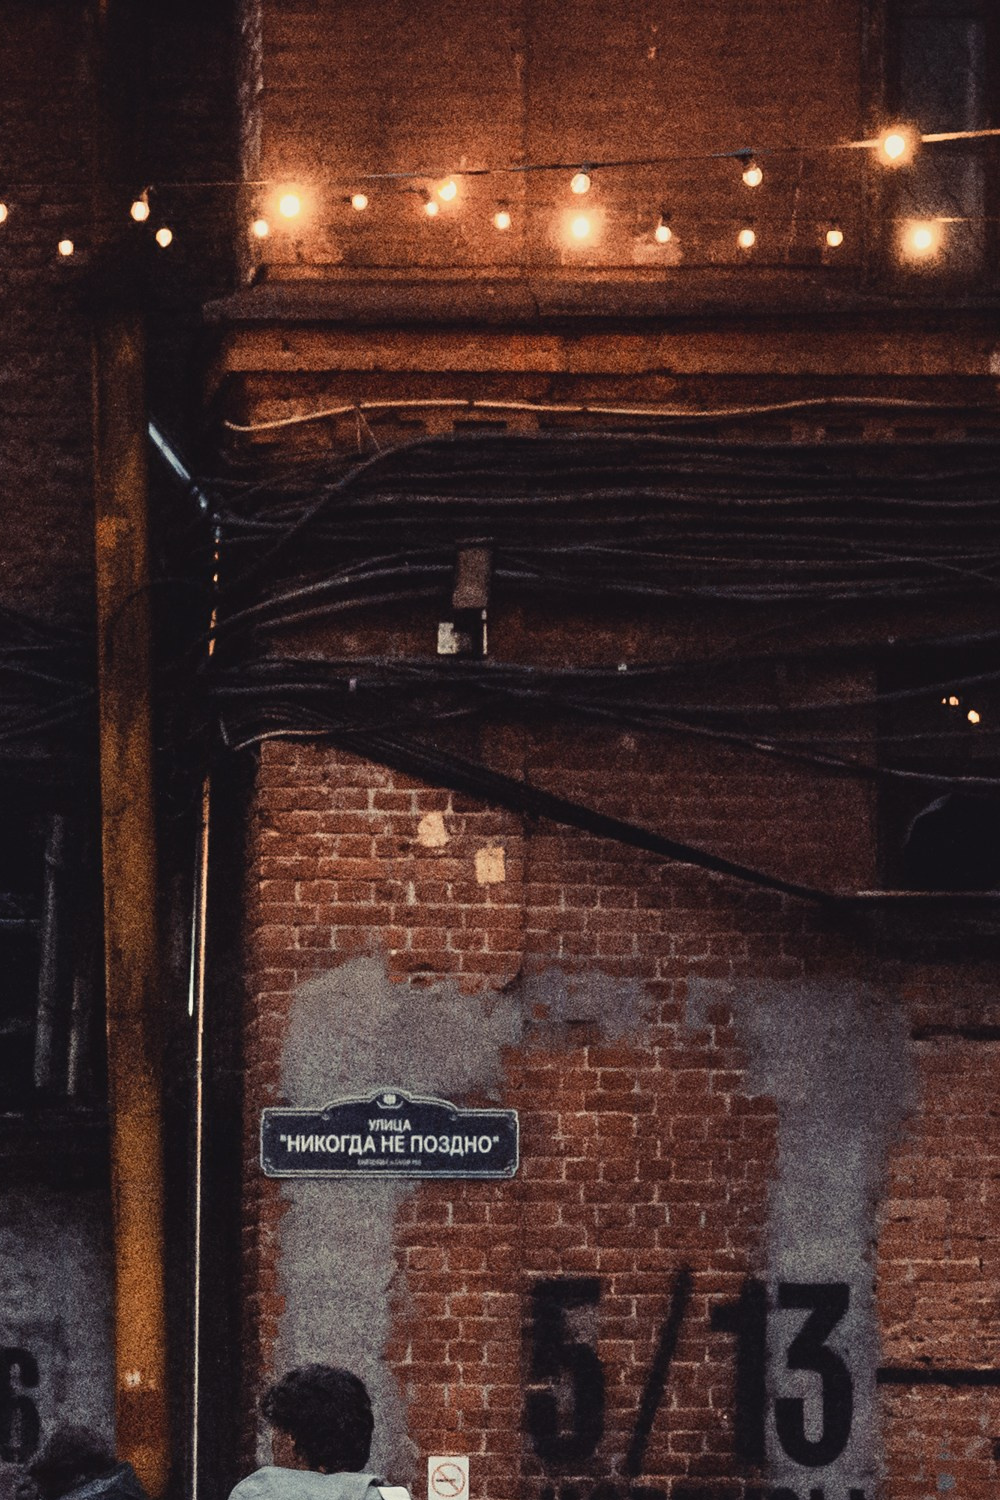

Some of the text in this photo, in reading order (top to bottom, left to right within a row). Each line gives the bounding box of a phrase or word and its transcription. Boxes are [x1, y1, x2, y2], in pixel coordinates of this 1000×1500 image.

[368, 1118, 412, 1133] УЛИЦА
[279, 1134, 500, 1157] "НИКОГДА НЕ ПОЗДНО"
[525, 1270, 854, 1476] 5/13
